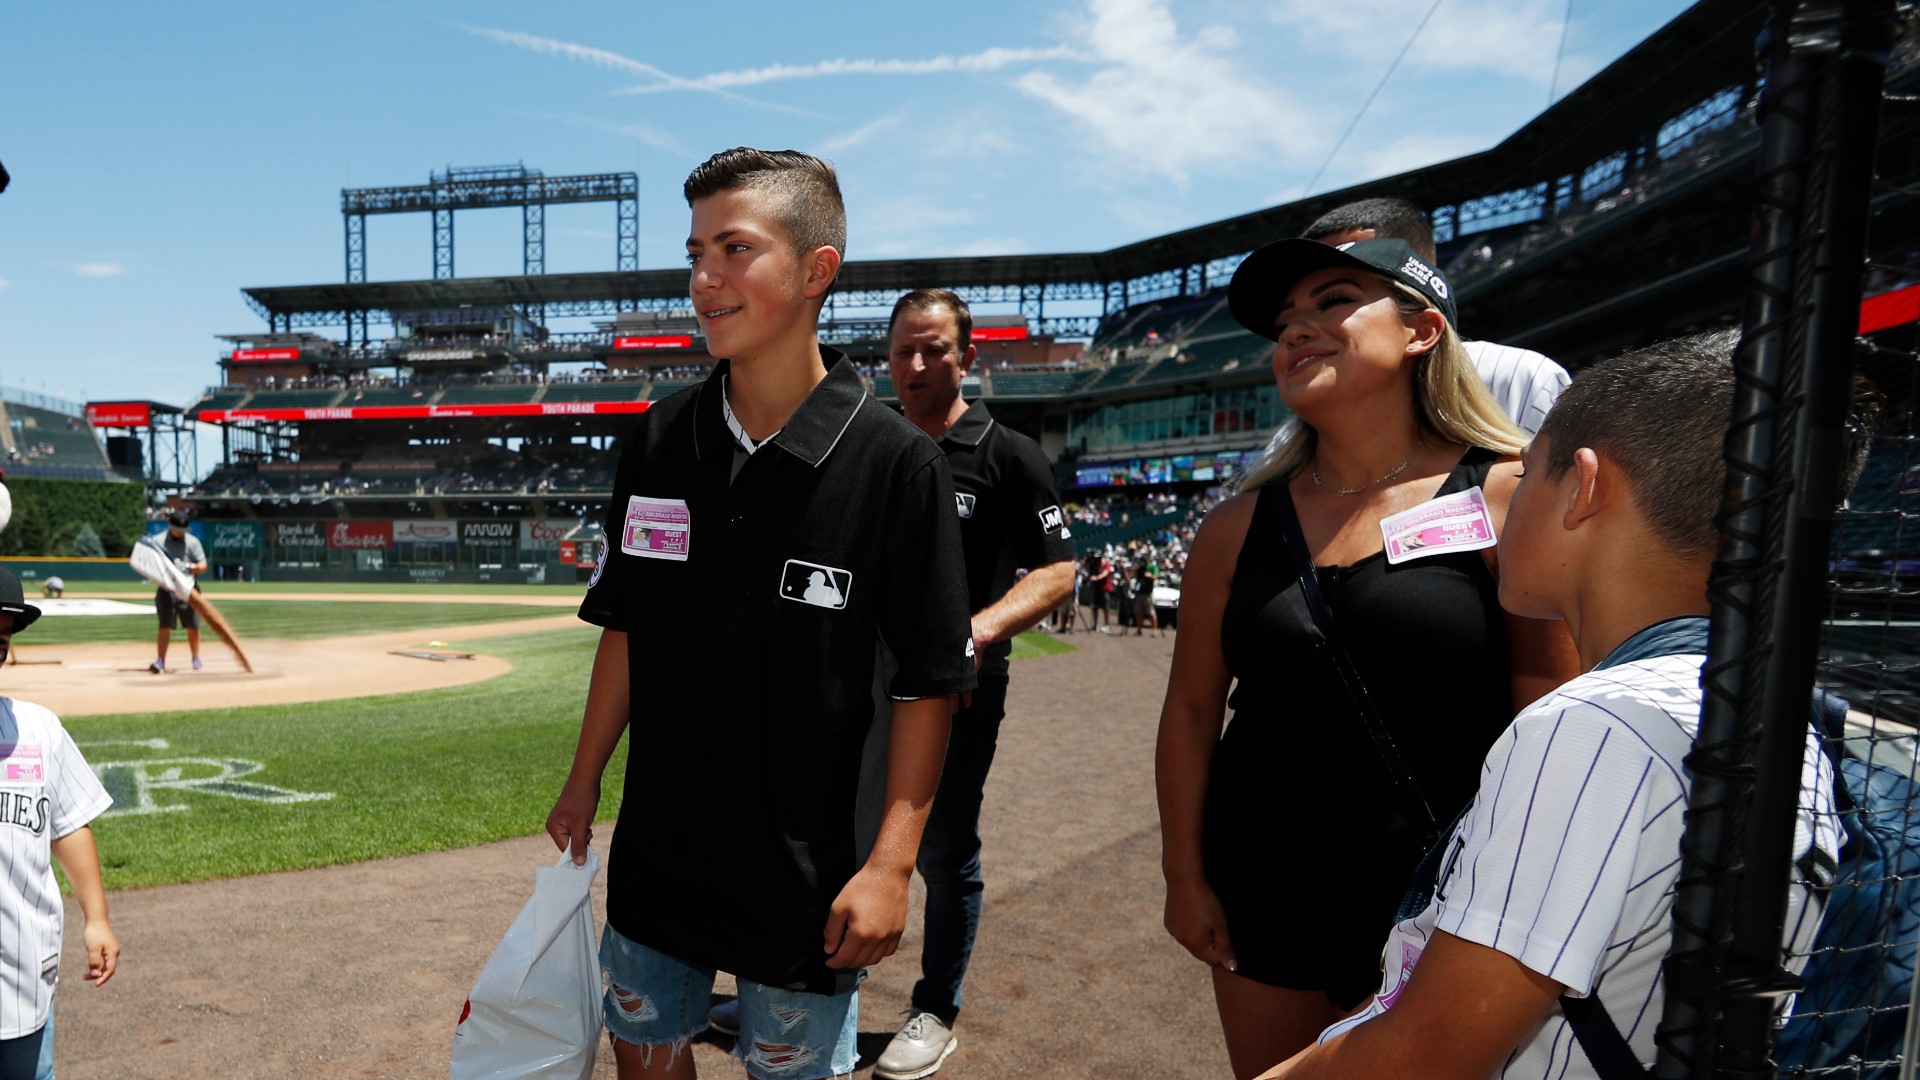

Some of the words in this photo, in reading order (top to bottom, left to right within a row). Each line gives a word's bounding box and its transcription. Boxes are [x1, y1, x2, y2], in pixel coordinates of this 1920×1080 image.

[1405, 262, 1430, 282] CARE
[1408, 256, 1433, 277] UMPS
[407, 351, 473, 361] SMASHBURGER
[304, 408, 325, 419] YOUTH
[327, 407, 352, 418] PARADE
[542, 403, 565, 414] YOUTH
[567, 402, 595, 413] PARADE
[1044, 510, 1061, 529] JM
[278, 523, 303, 535] Bank
[304, 523, 315, 535] of
[1442, 522, 1473, 532] GUEST
[665, 530, 682, 538] GUEST
[278, 535, 326, 547] Colorado
